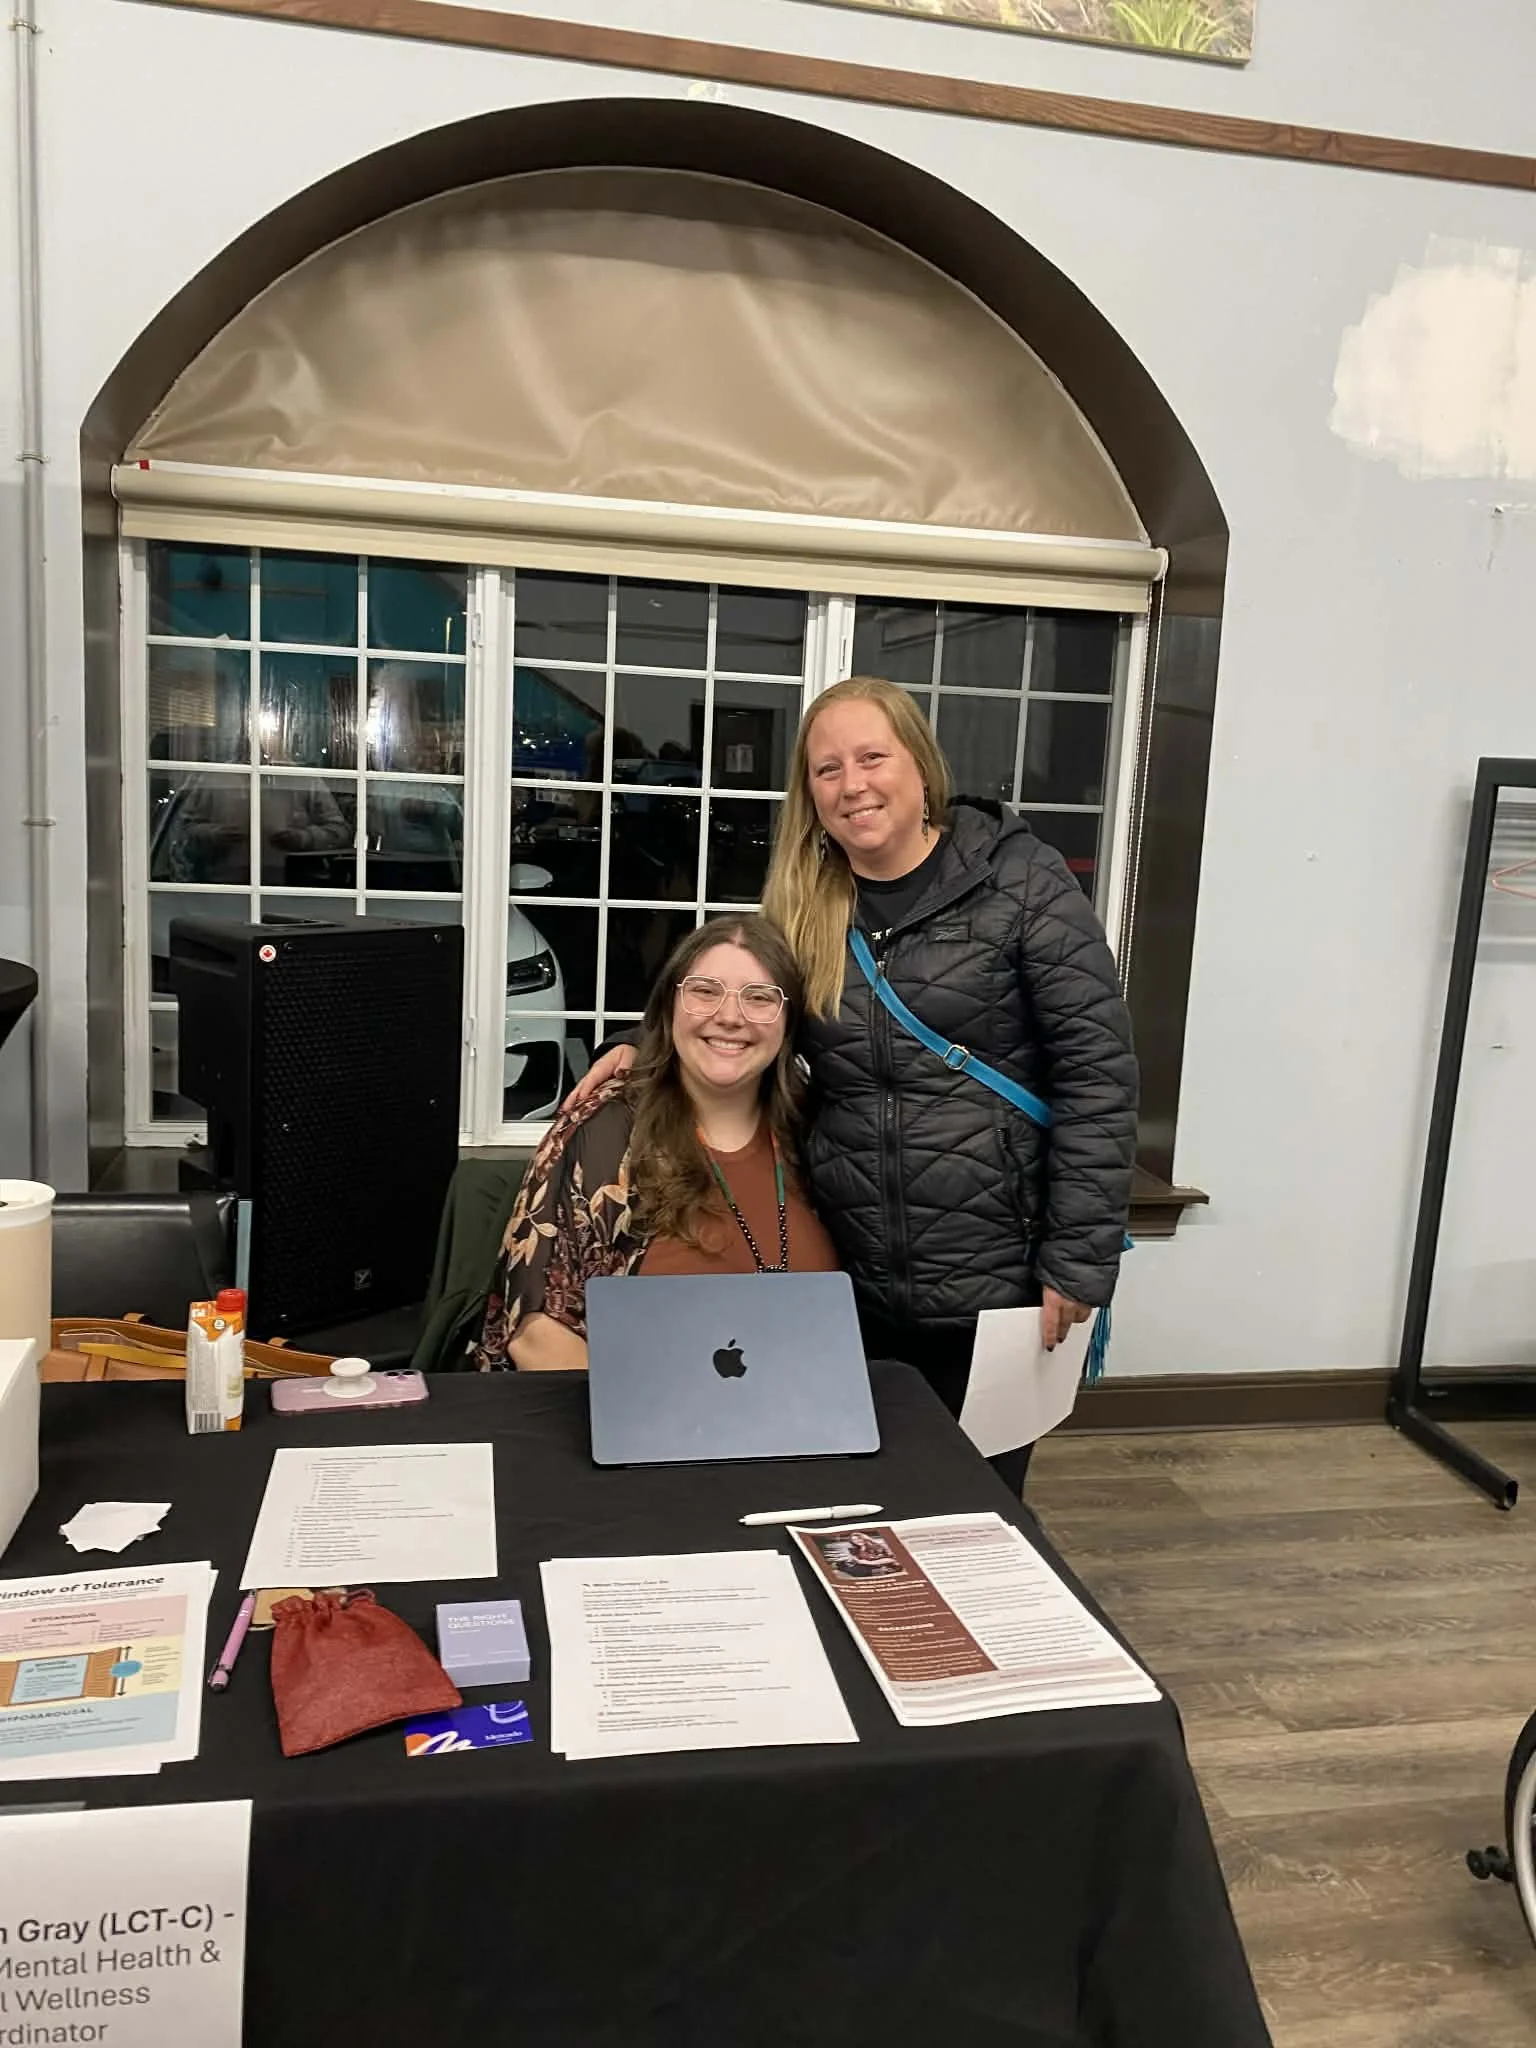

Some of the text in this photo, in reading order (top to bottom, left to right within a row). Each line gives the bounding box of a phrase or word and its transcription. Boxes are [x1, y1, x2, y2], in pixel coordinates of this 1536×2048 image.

[0, 1586, 56, 1600] indow
[59, 1583, 81, 1594] of
[83, 1576, 166, 1592] Tolerance
[18, 1919, 90, 1944] Gray
[99, 1904, 213, 1942] (LCT-C)
[97, 1944, 192, 1974] Health
[199, 1939, 222, 1964] &
[15, 1986, 151, 2012] Wellness
